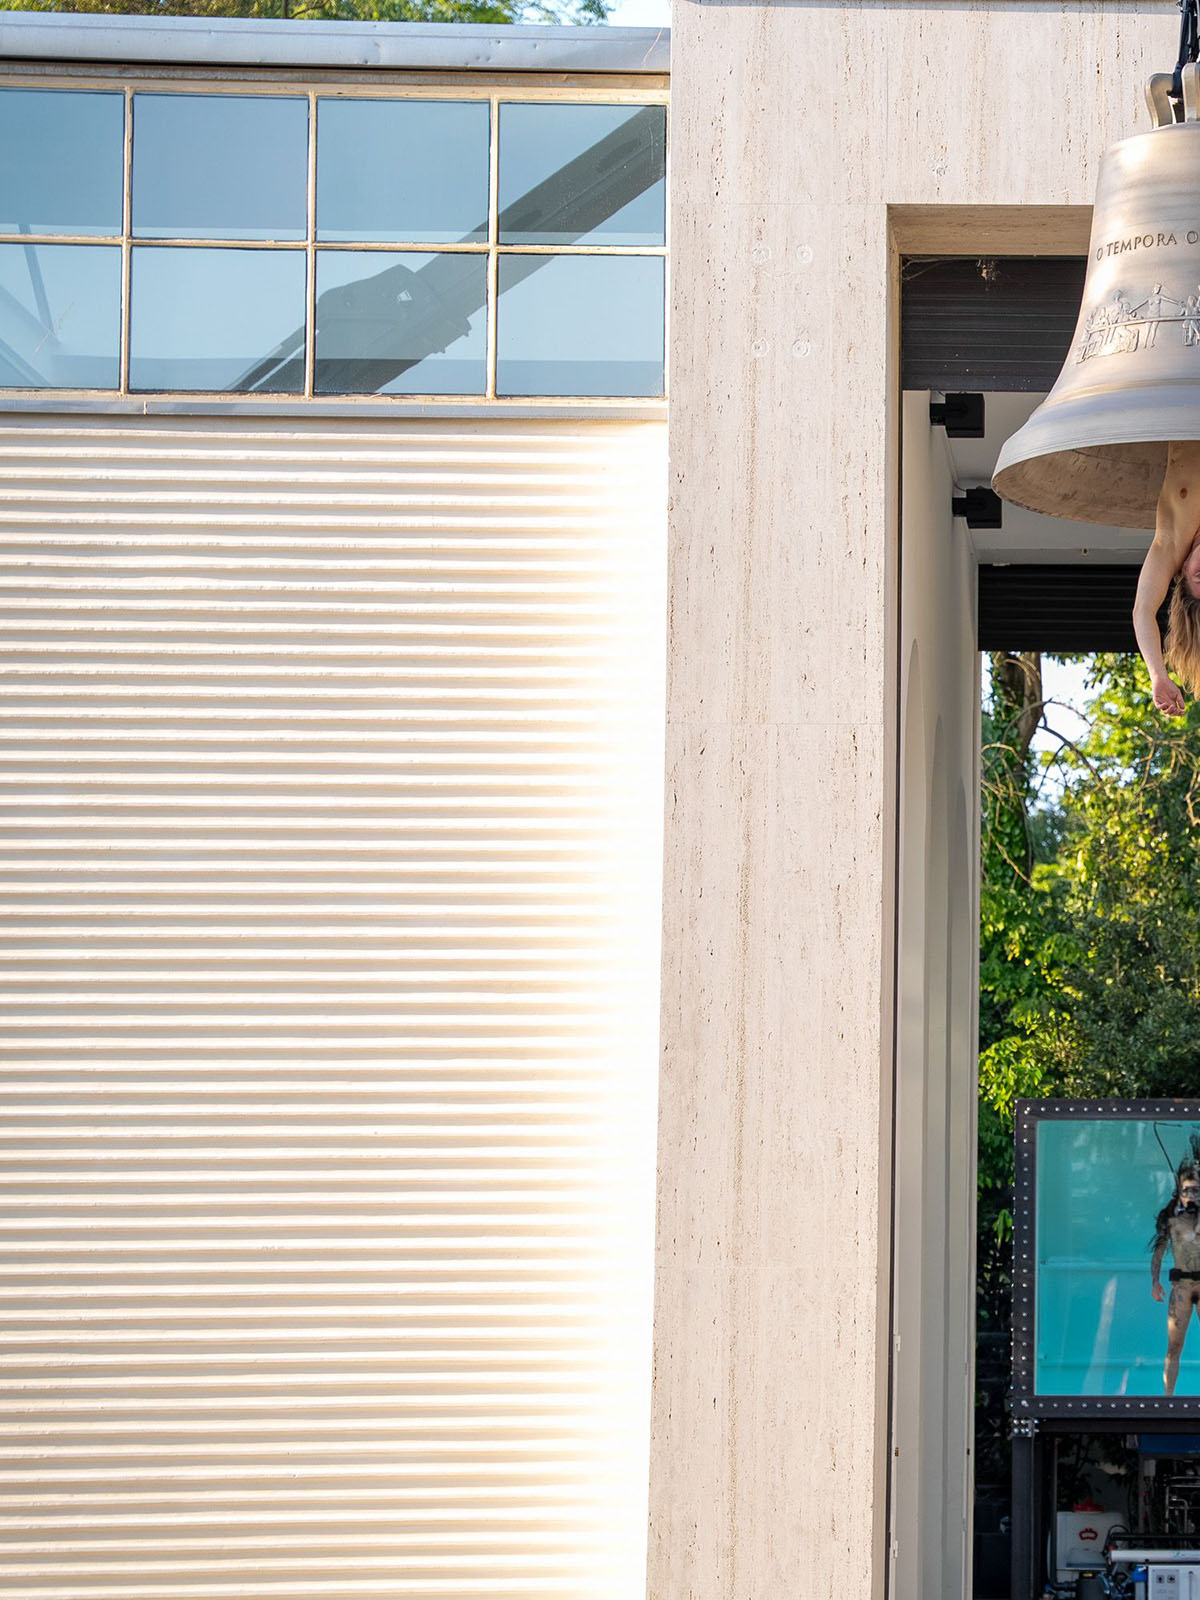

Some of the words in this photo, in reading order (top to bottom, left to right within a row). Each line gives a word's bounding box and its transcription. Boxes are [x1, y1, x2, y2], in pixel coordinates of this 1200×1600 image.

[1096, 247, 1104, 261] O
[1107, 232, 1177, 256] TEMPORA
[1187, 230, 1199, 244] O
